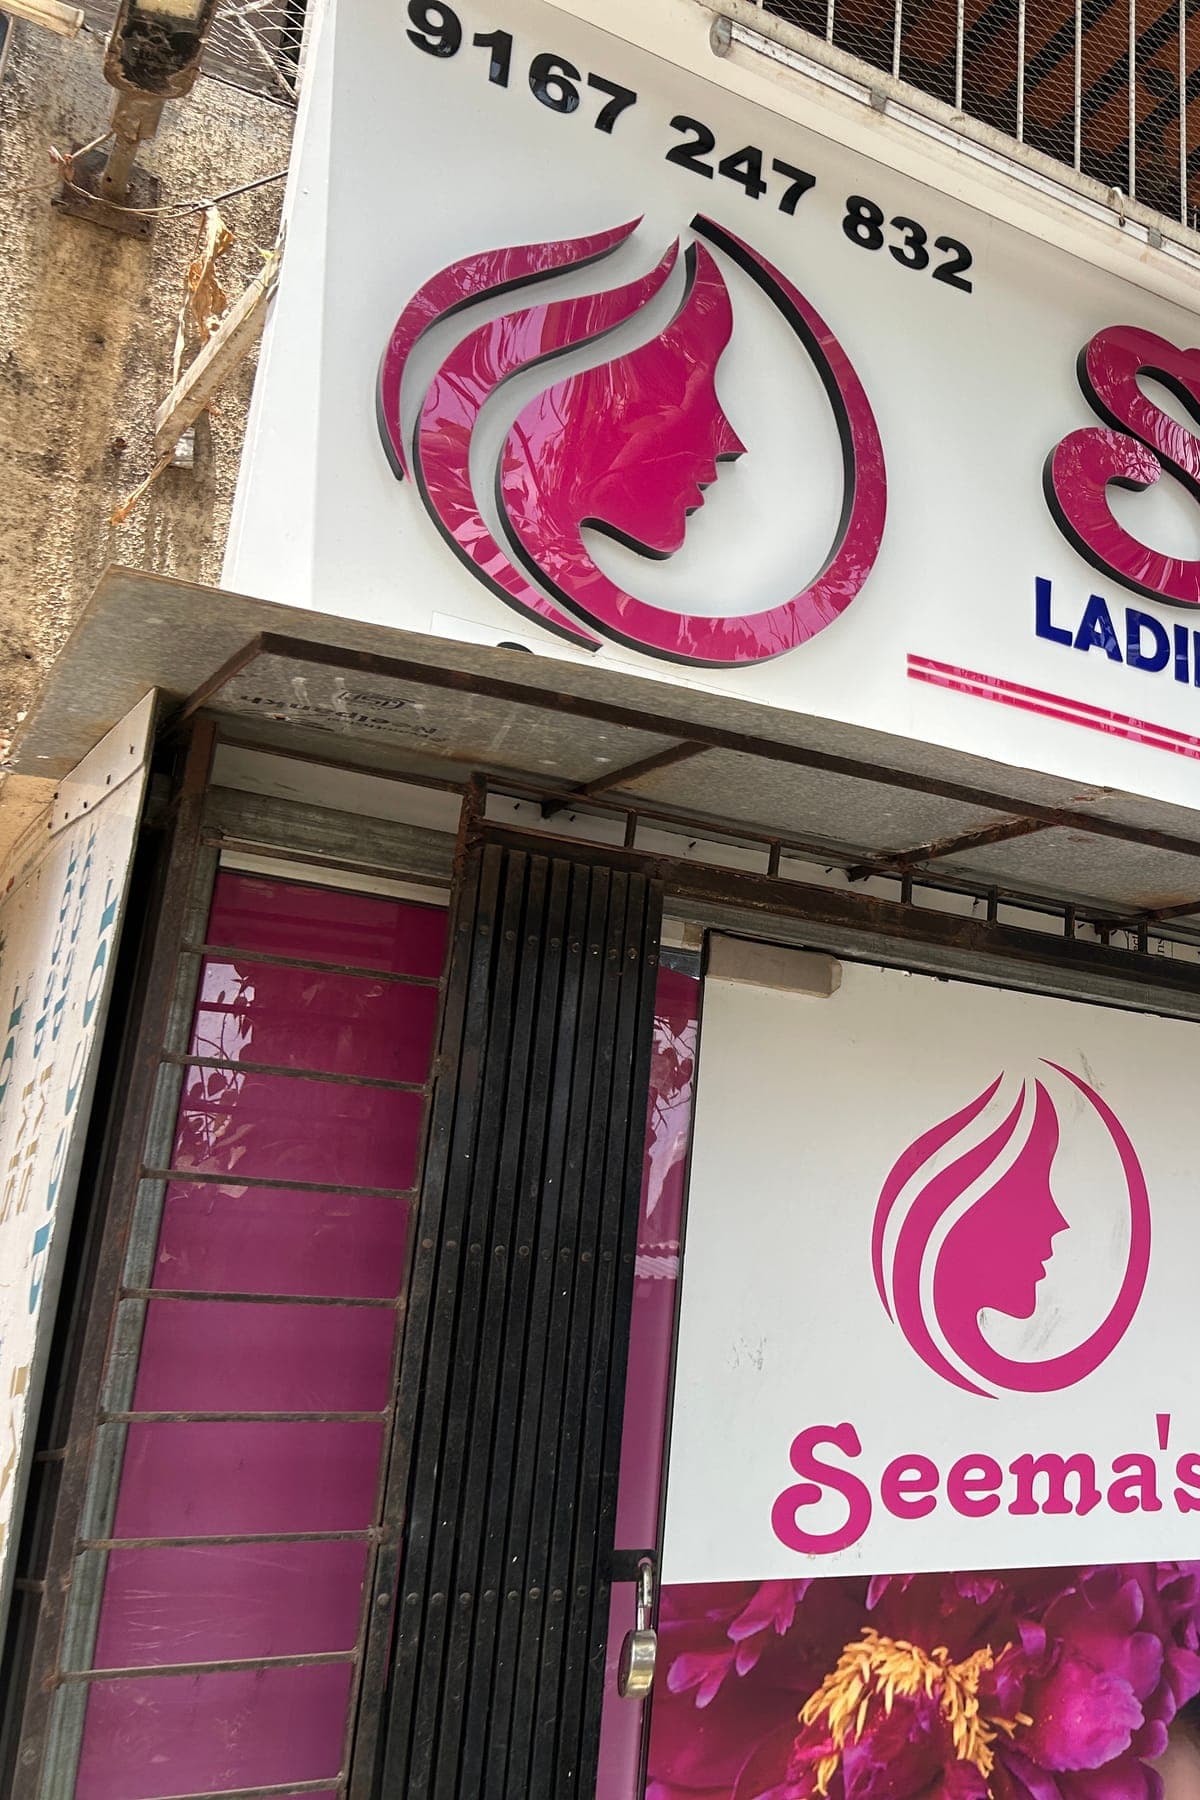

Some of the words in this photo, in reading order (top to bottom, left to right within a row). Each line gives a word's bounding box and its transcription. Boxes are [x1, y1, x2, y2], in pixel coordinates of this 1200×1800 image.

[405, 0, 637, 134] 9167
[665, 115, 816, 216] 247
[842, 194, 973, 294] 832
